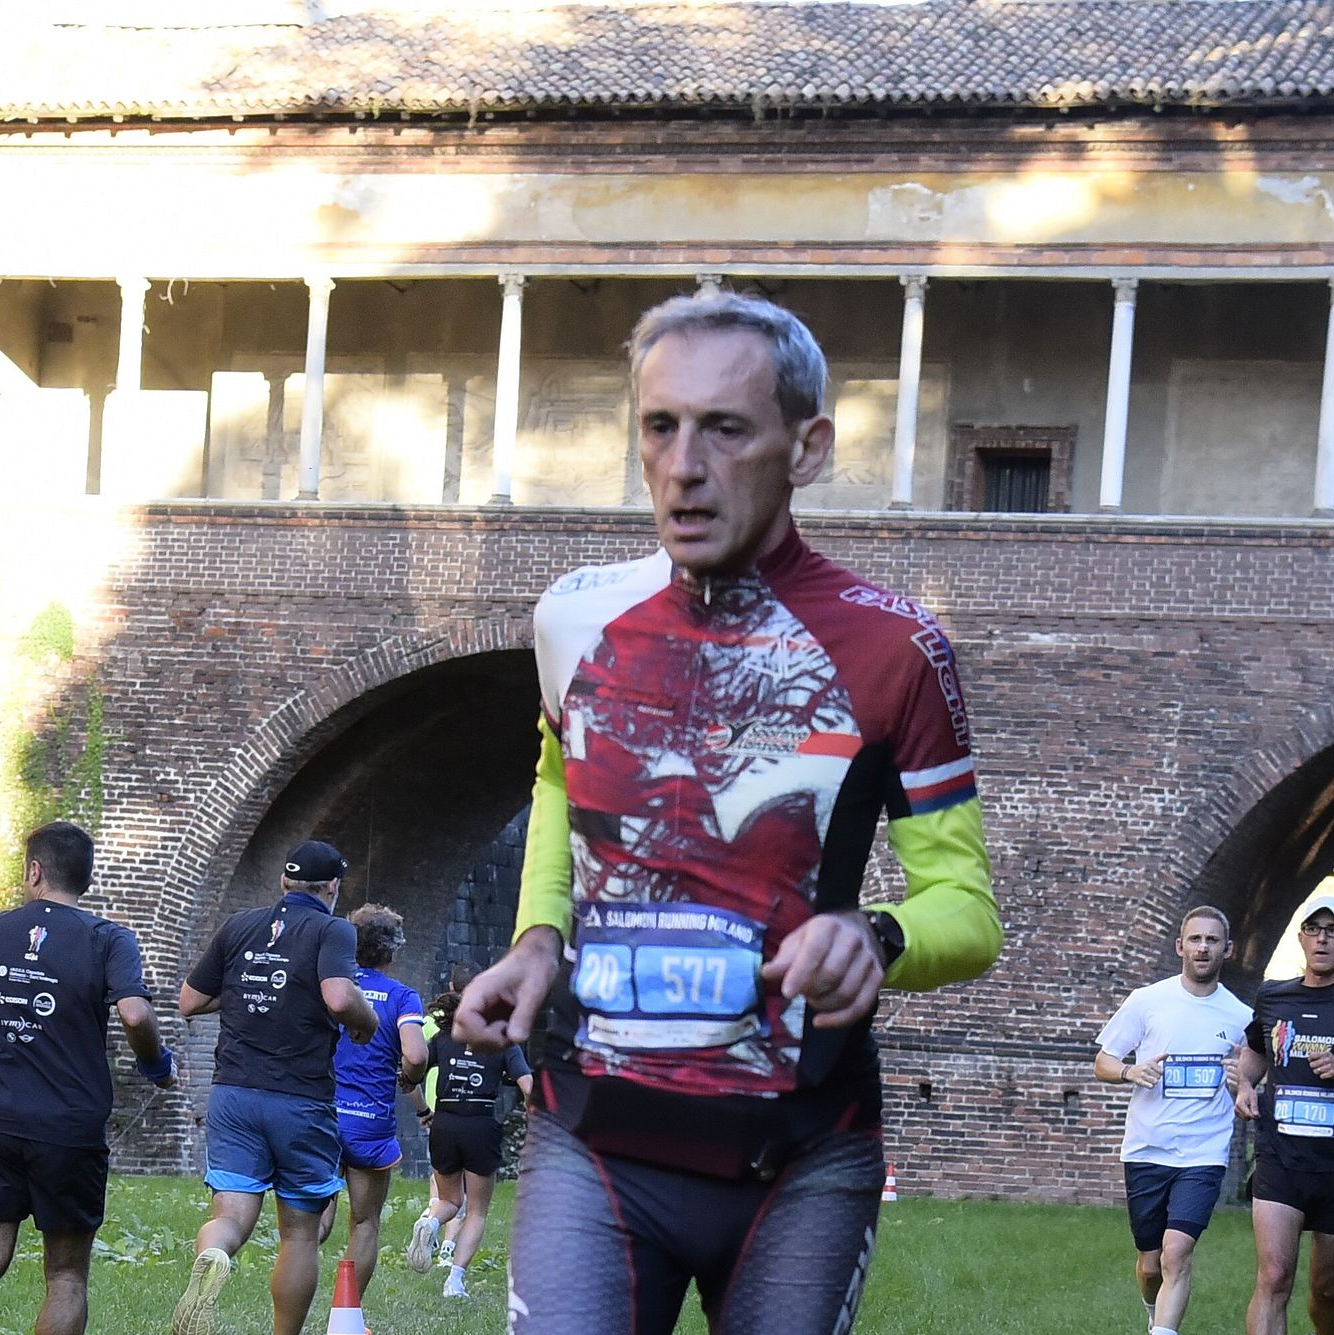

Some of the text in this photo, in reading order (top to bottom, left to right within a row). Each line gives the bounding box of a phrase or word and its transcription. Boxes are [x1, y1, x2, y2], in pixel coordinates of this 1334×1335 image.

[605, 910, 657, 930] SALOMON
[582, 952, 620, 1002] 20
[661, 955, 728, 1005] 577
[1165, 1068, 1180, 1084] 20
[1194, 1068, 1216, 1084] 507
[1275, 1102, 1288, 1119] 20
[1303, 1104, 1327, 1121] 170
